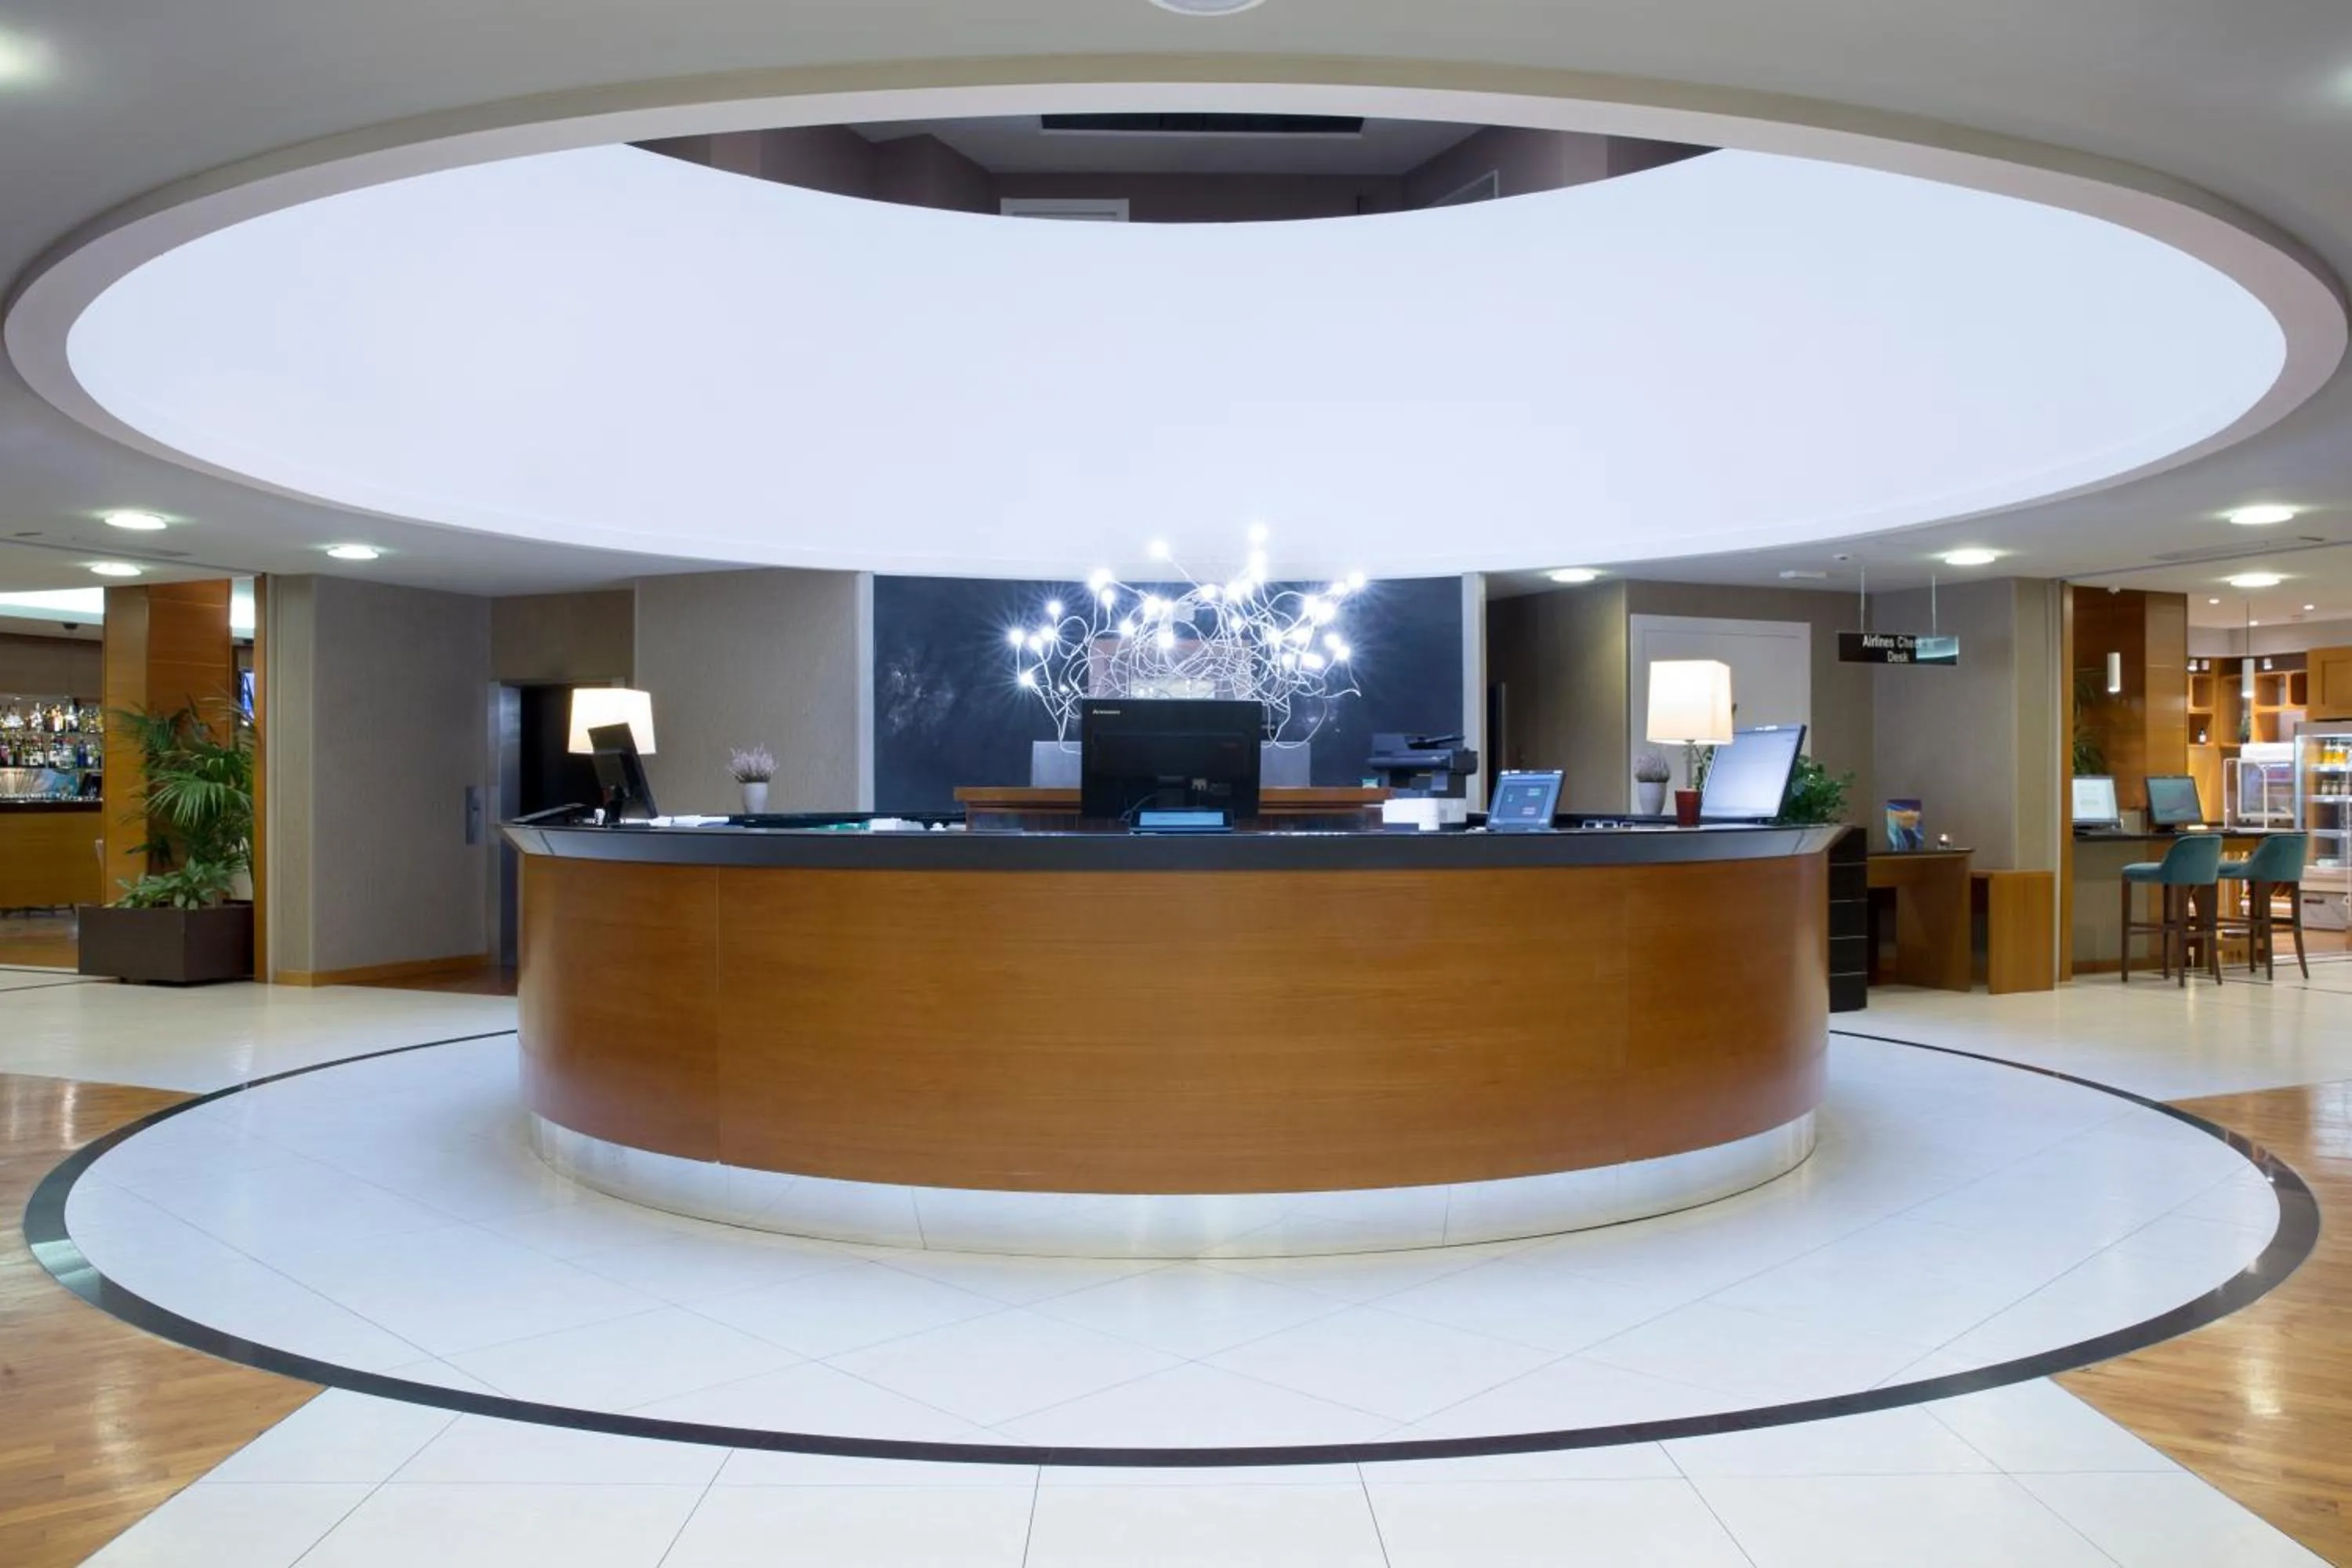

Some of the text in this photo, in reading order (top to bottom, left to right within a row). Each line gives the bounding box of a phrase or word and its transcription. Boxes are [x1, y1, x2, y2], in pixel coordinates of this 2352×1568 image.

[1863, 635, 1894, 648] Airlines
[1896, 636, 1922, 649] Che
[1888, 651, 1908, 662] Desk
